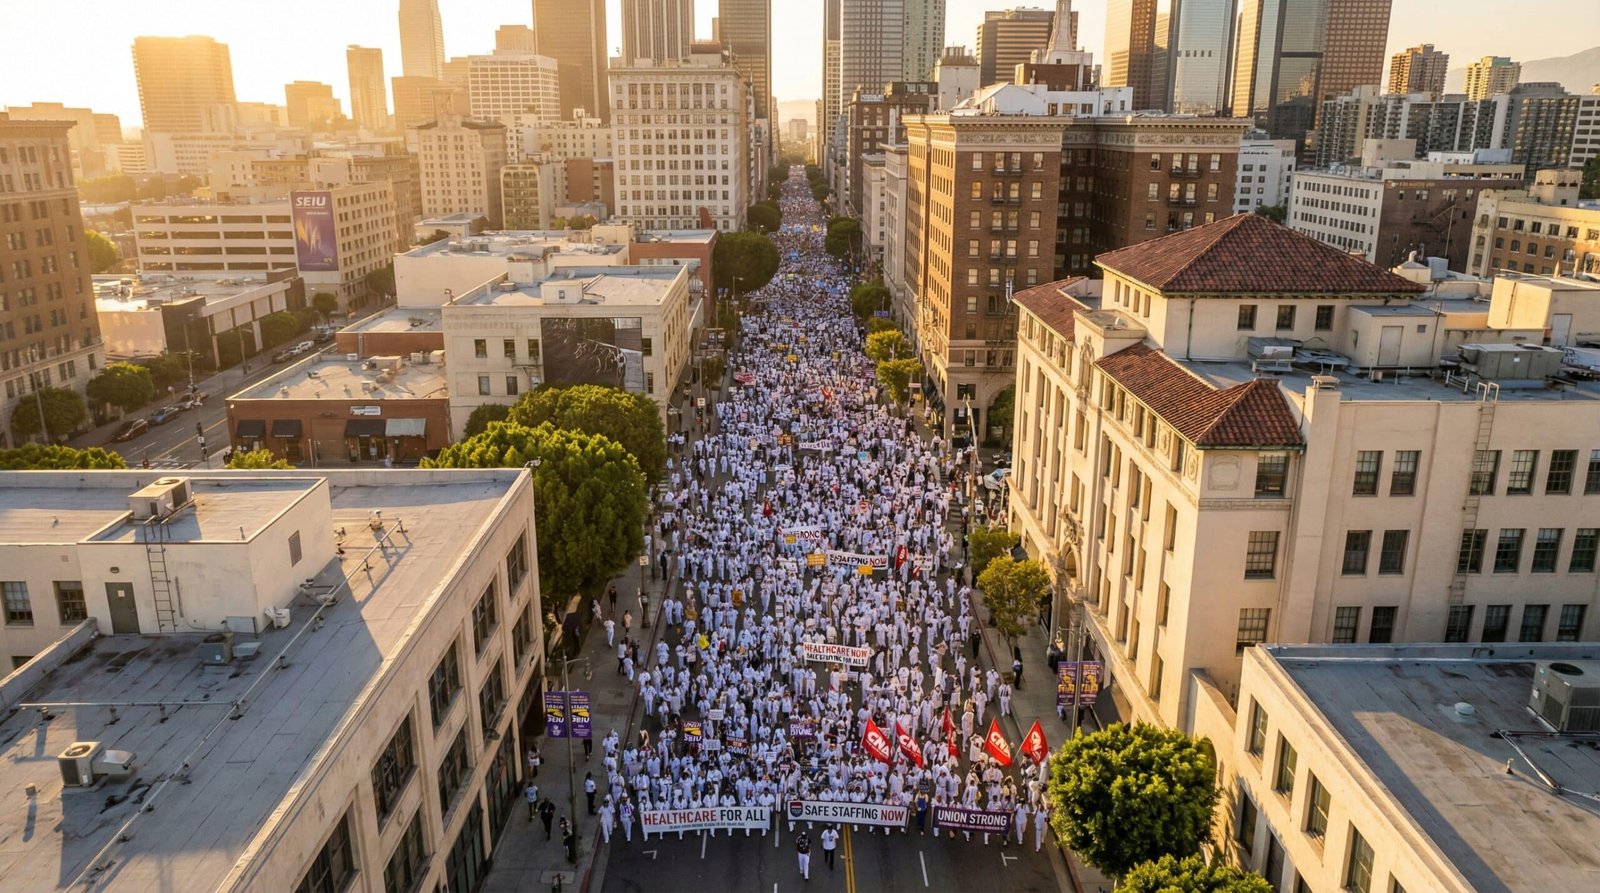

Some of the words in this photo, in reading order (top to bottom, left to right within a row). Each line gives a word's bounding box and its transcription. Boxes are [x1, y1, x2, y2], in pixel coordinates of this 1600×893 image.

[296, 197, 326, 207] SEIU
[870, 557, 887, 566] NOW
[804, 643, 849, 656] HEALTHCARE
[851, 649, 868, 658] NOW
[867, 731, 889, 757] CNA
[643, 809, 717, 826] HEALTHCARE
[720, 809, 742, 821] FOR
[745, 809, 766, 821] ALL
[804, 804, 830, 817] SAFE
[831, 806, 878, 820] STAFFING
[880, 810, 905, 822] NOW
[937, 809, 967, 824] UNION
[969, 813, 1007, 826] STRONG
